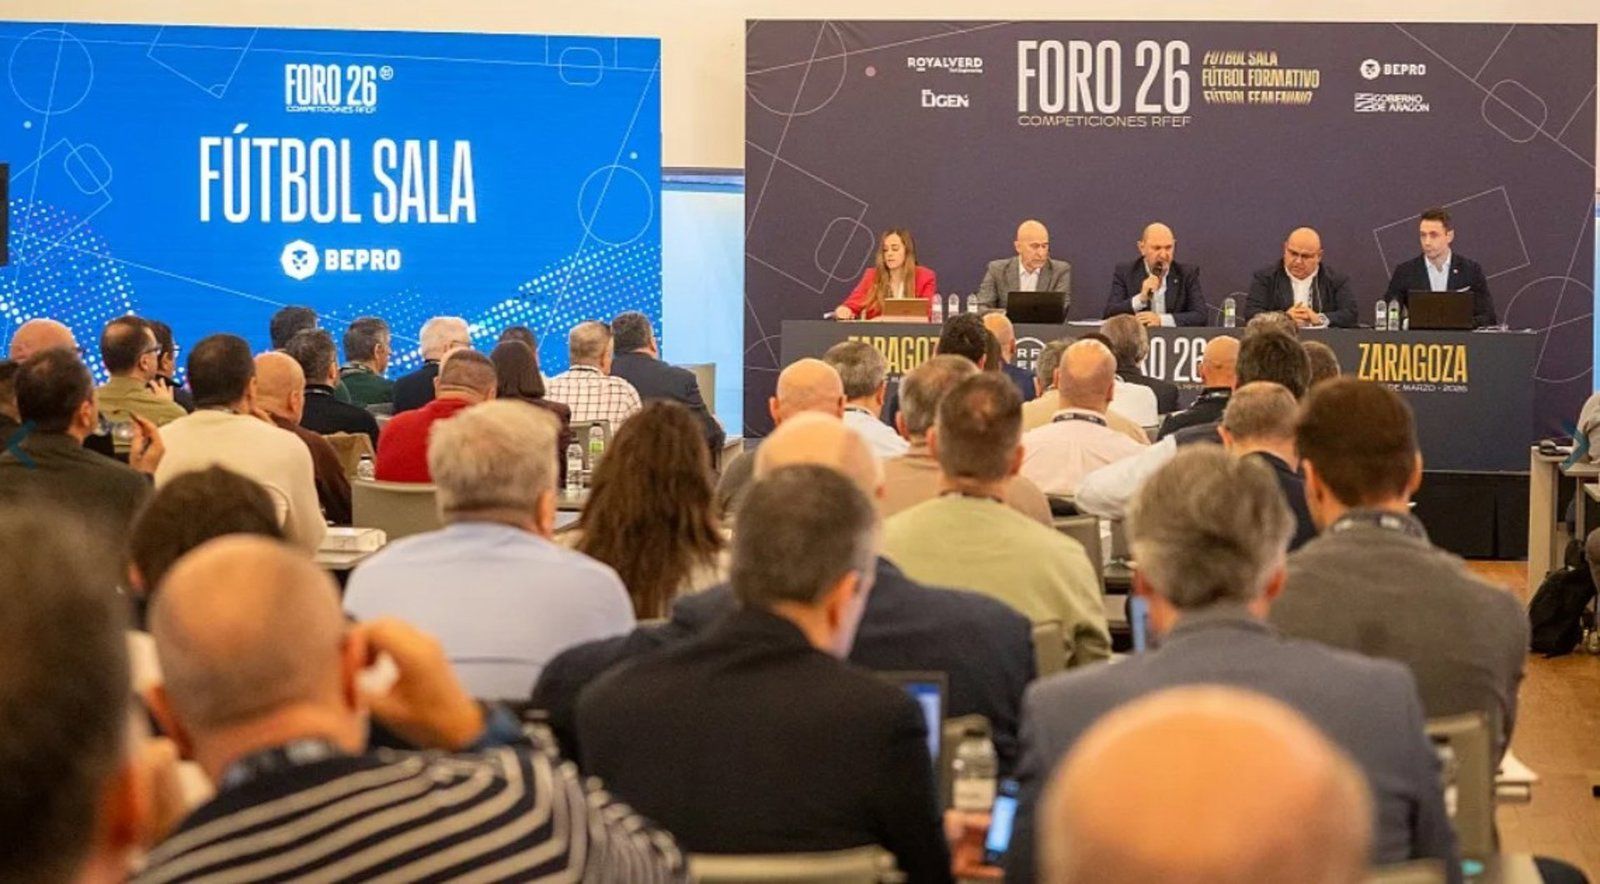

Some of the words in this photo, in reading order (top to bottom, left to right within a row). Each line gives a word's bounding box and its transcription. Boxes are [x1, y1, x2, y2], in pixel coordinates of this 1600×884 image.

[907, 57, 983, 68] ROYALVERD
[1248, 51, 1278, 66] SALA
[1384, 64, 1426, 75] BEPRO
[285, 64, 341, 105] FORO
[347, 65, 377, 106] 26
[1017, 40, 1122, 114] FORO
[1135, 40, 1191, 114] 26
[1202, 66, 1246, 87] FÚTBOL
[1248, 68, 1320, 88] FORMATIVO
[1018, 116, 1147, 127] COMPETICIONES
[1151, 116, 1192, 127] RFEF
[199, 123, 362, 224] FÚTBOL
[372, 138, 477, 224] SALA
[325, 249, 401, 271] BEPRO
[1174, 336, 1207, 383] 26
[1359, 343, 1468, 383] ZARAGOZA
